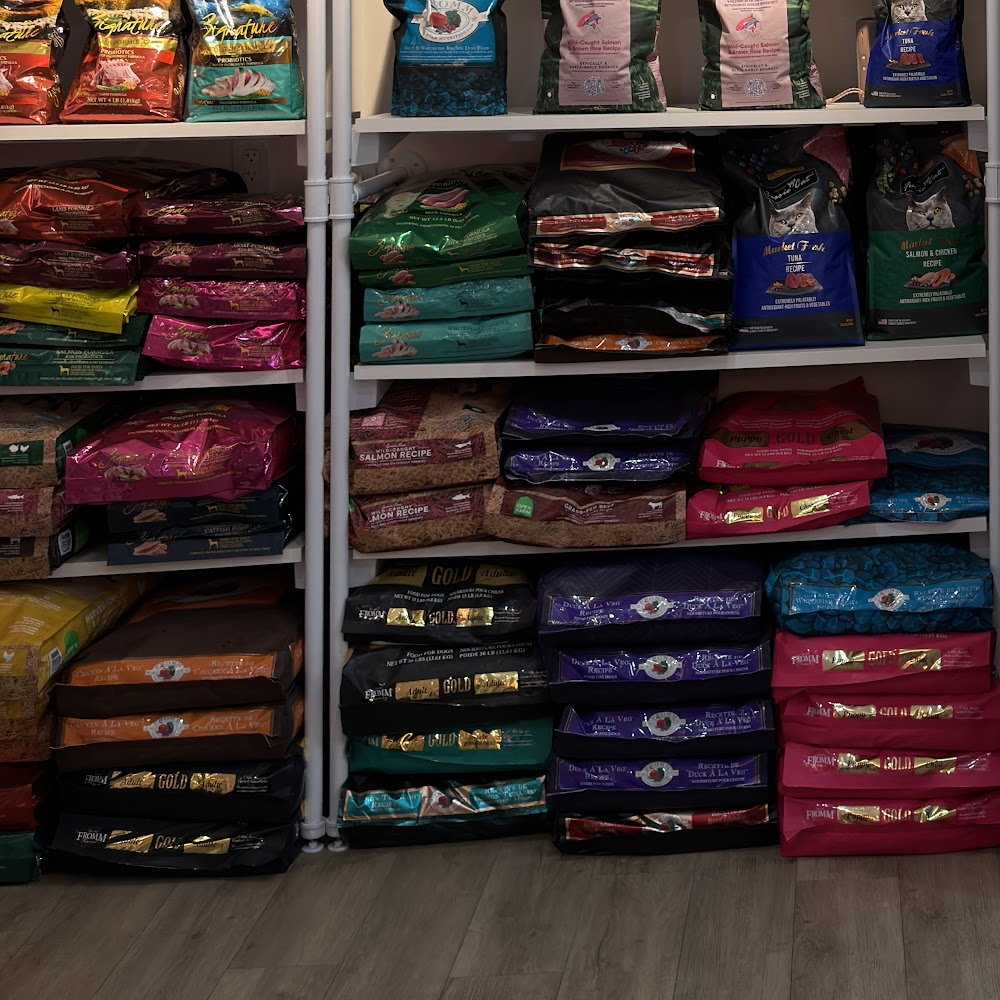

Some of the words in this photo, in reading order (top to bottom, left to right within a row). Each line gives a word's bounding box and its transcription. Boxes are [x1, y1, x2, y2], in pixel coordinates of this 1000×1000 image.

[202, 13, 278, 43] Zignature
[762, 242, 796, 256] Market
[906, 250, 928, 258] SALMON
[936, 248, 958, 256] CHICKEN
[786, 264, 805, 272] RECIPE
[730, 436, 762, 444] Puppy
[776, 432, 815, 444] GOLD
[359, 451, 398, 462] SALMON
[400, 449, 432, 459] RECIPE
[371, 504, 412, 515] WILD-CAUGHT
[400, 506, 429, 517] RECIPE
[564, 502, 594, 514] GRASS-FED
[432, 566, 472, 586] GOLD
[429, 610, 454, 625] GOLD
[792, 654, 819, 664] FROMM
[868, 651, 896, 666] GOLD
[408, 687, 428, 696] Adult
[443, 678, 472, 694] GOLD
[365, 689, 392, 700] FROMM
[428, 734, 456, 747] GOLD
[807, 755, 834, 766] FROMM
[884, 756, 911, 770] GOLD
[158, 772, 187, 790] GOLD
[806, 810, 834, 820] FROMM
[77, 831, 107, 842] FROMM
